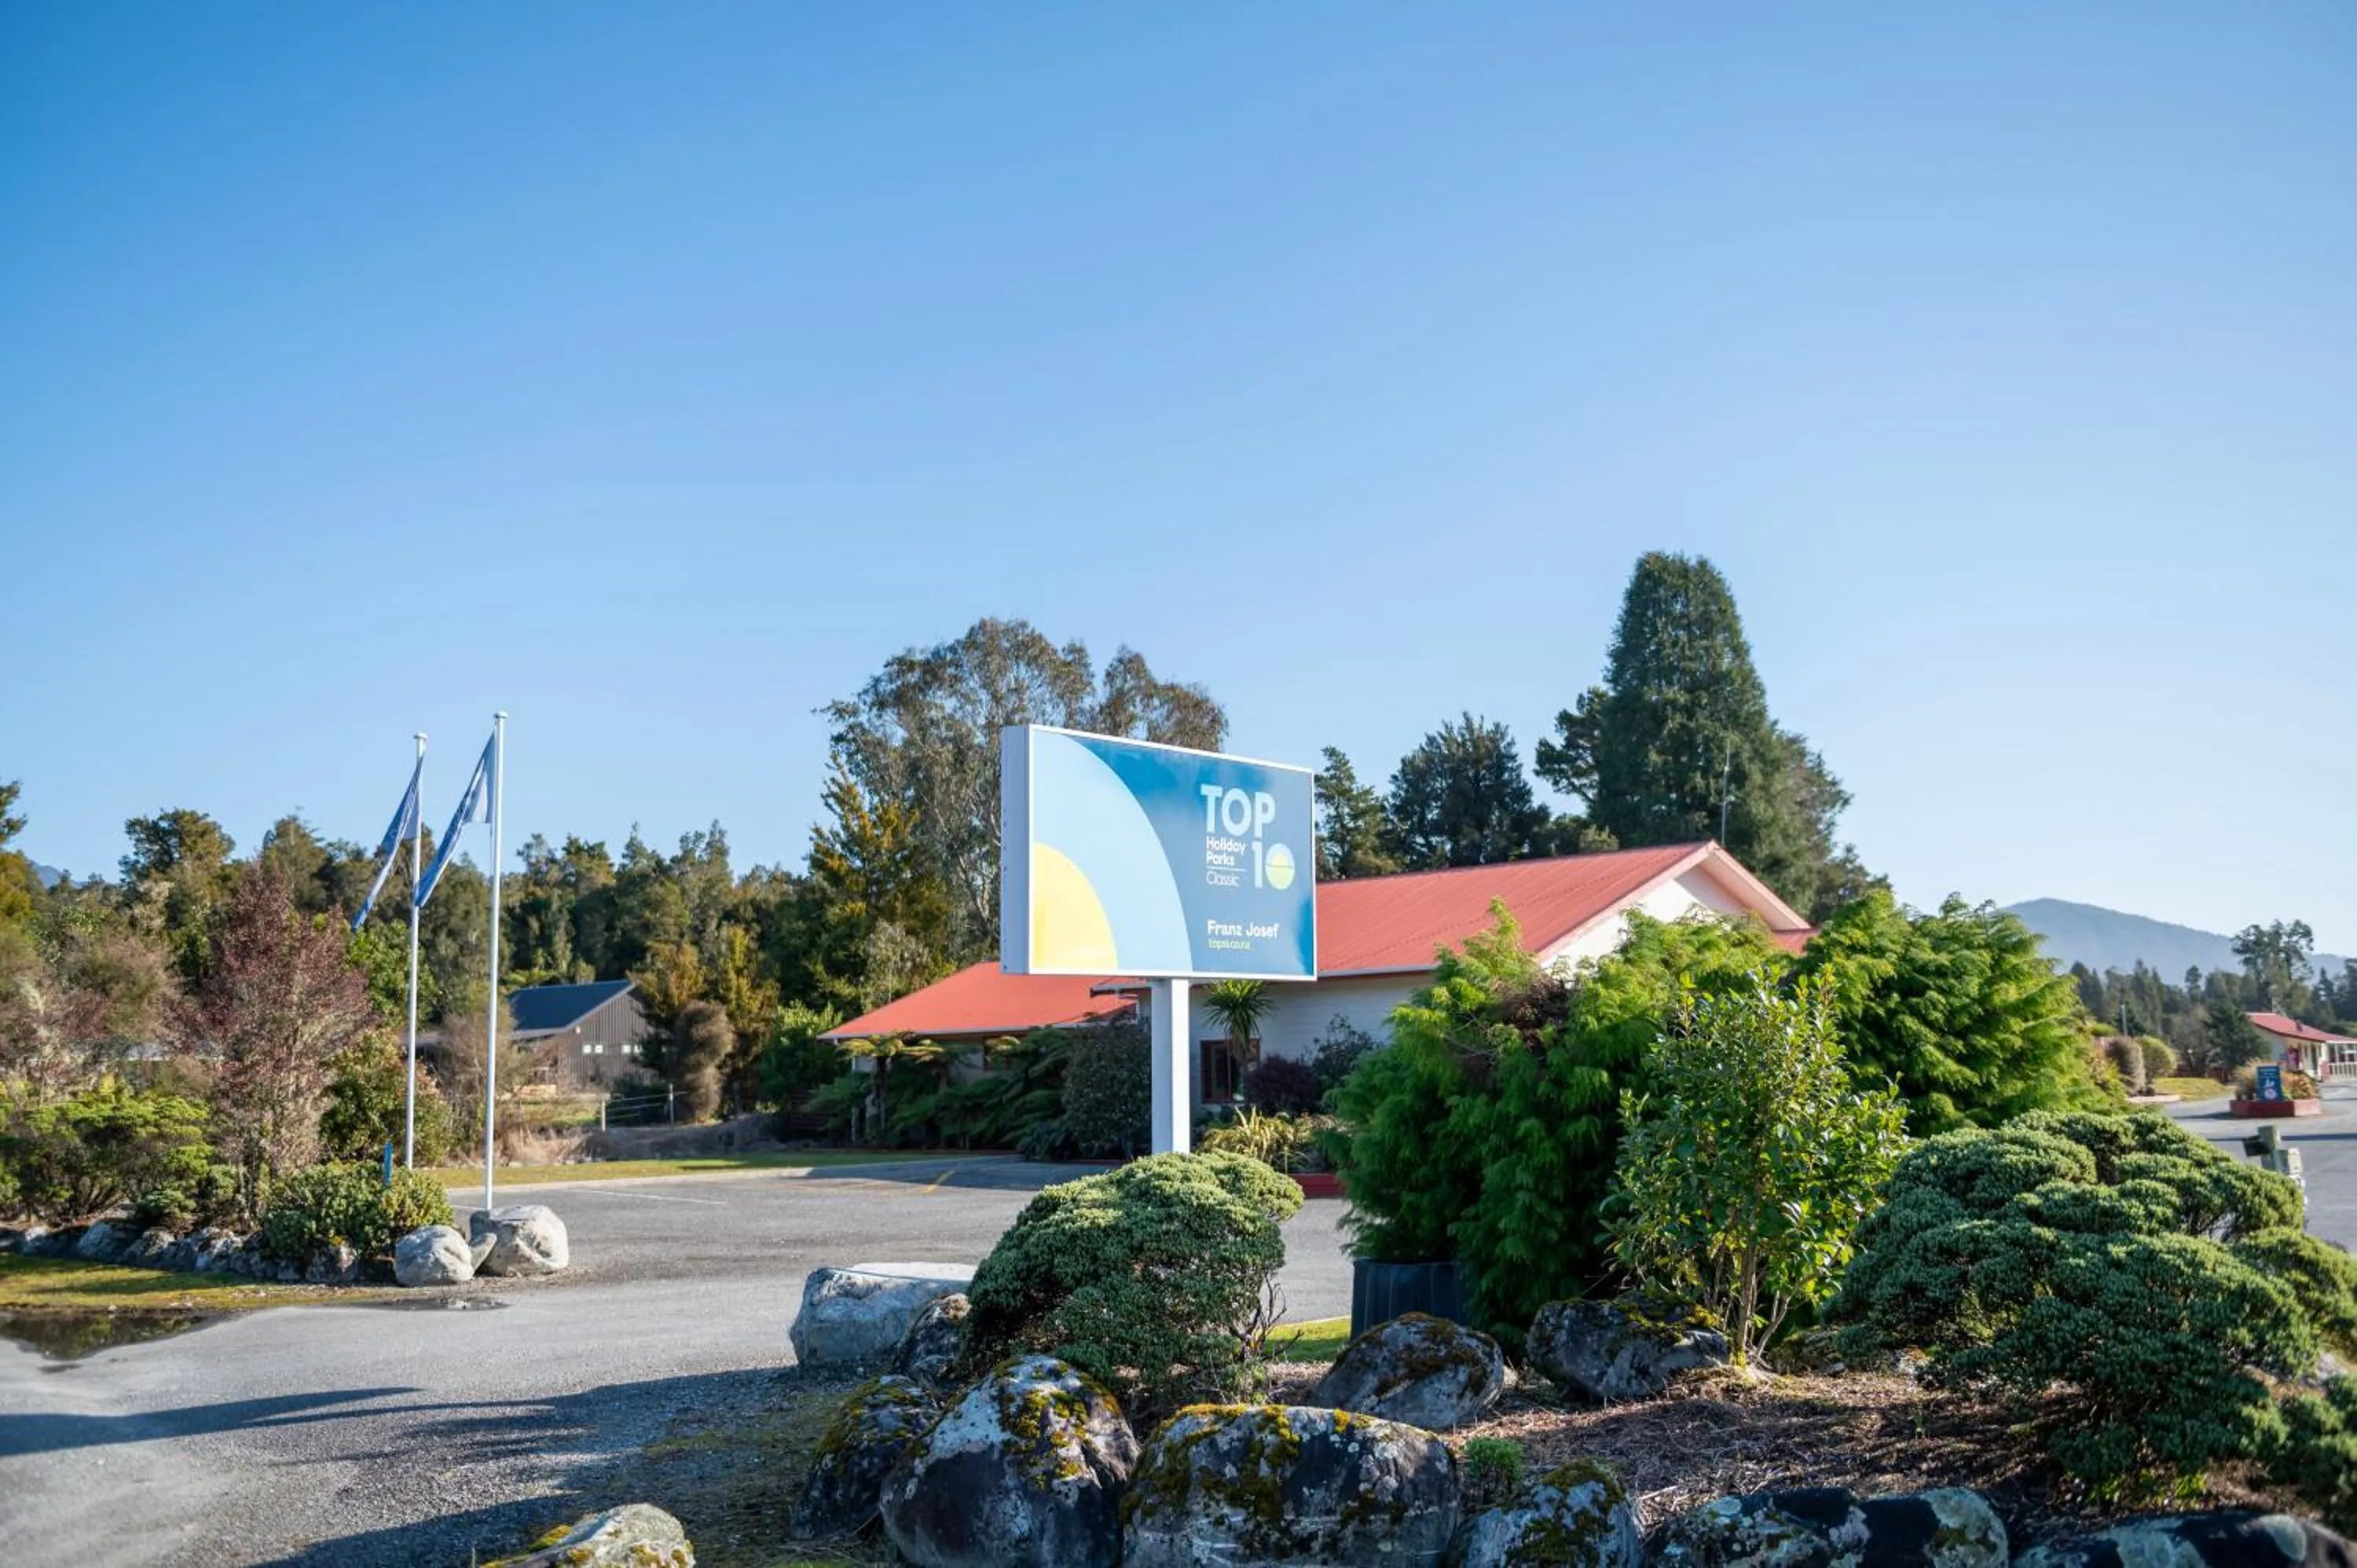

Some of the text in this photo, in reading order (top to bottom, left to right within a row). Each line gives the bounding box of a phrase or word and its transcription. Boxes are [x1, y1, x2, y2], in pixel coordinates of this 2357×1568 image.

[1200, 784, 1275, 838] TOP
[1207, 835, 1245, 855] Holiday
[1207, 851, 1235, 866] Parks
[1252, 841, 1295, 890] 10
[1207, 919, 1279, 938] Franz Josef
